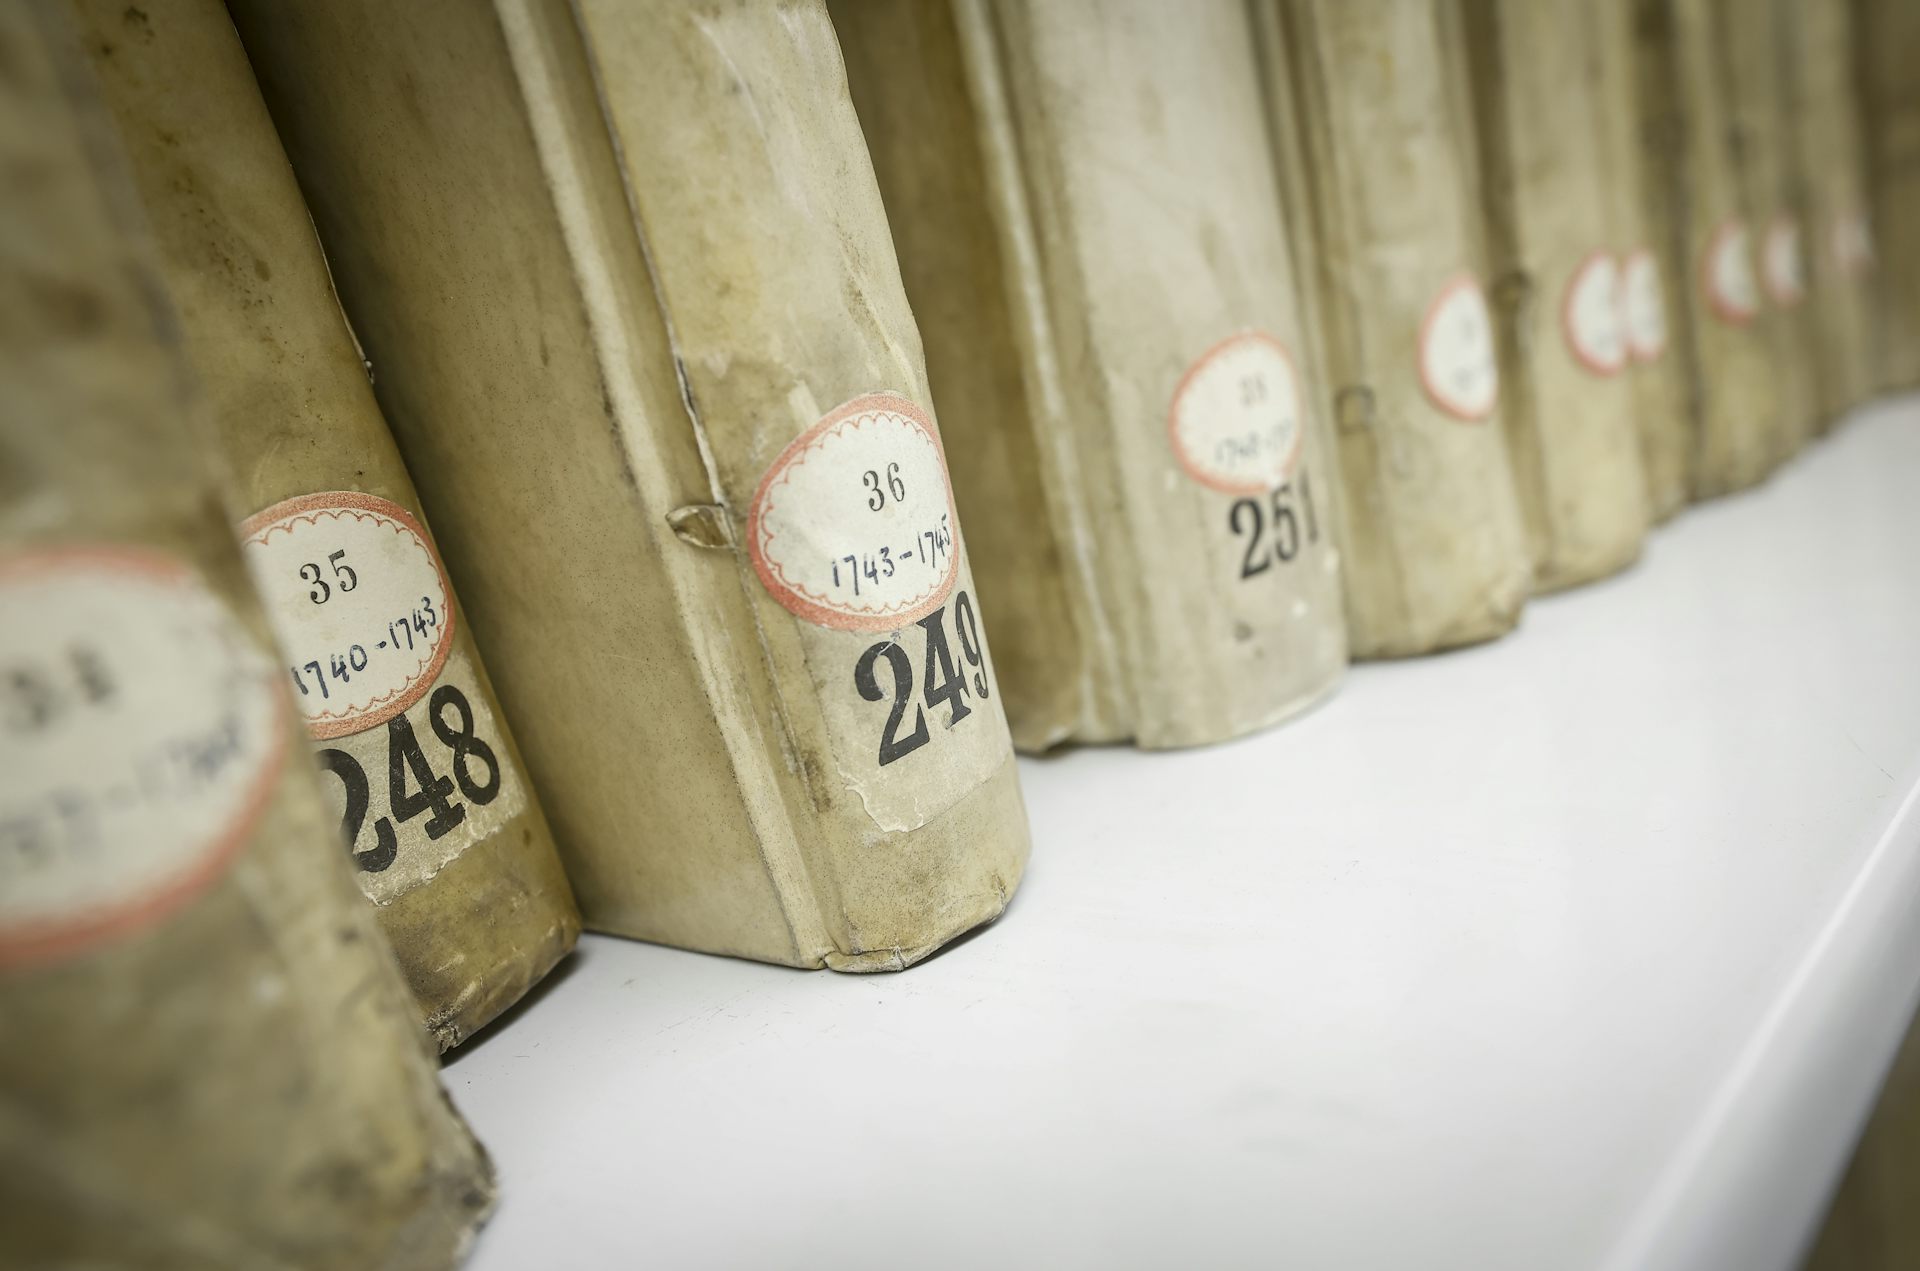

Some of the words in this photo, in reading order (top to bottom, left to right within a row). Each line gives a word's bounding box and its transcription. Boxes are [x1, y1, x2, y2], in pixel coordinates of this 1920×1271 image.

[863, 462, 906, 512] 36
[1229, 465, 1319, 581] 251
[299, 549, 358, 604] 35
[854, 590, 989, 767] 249
